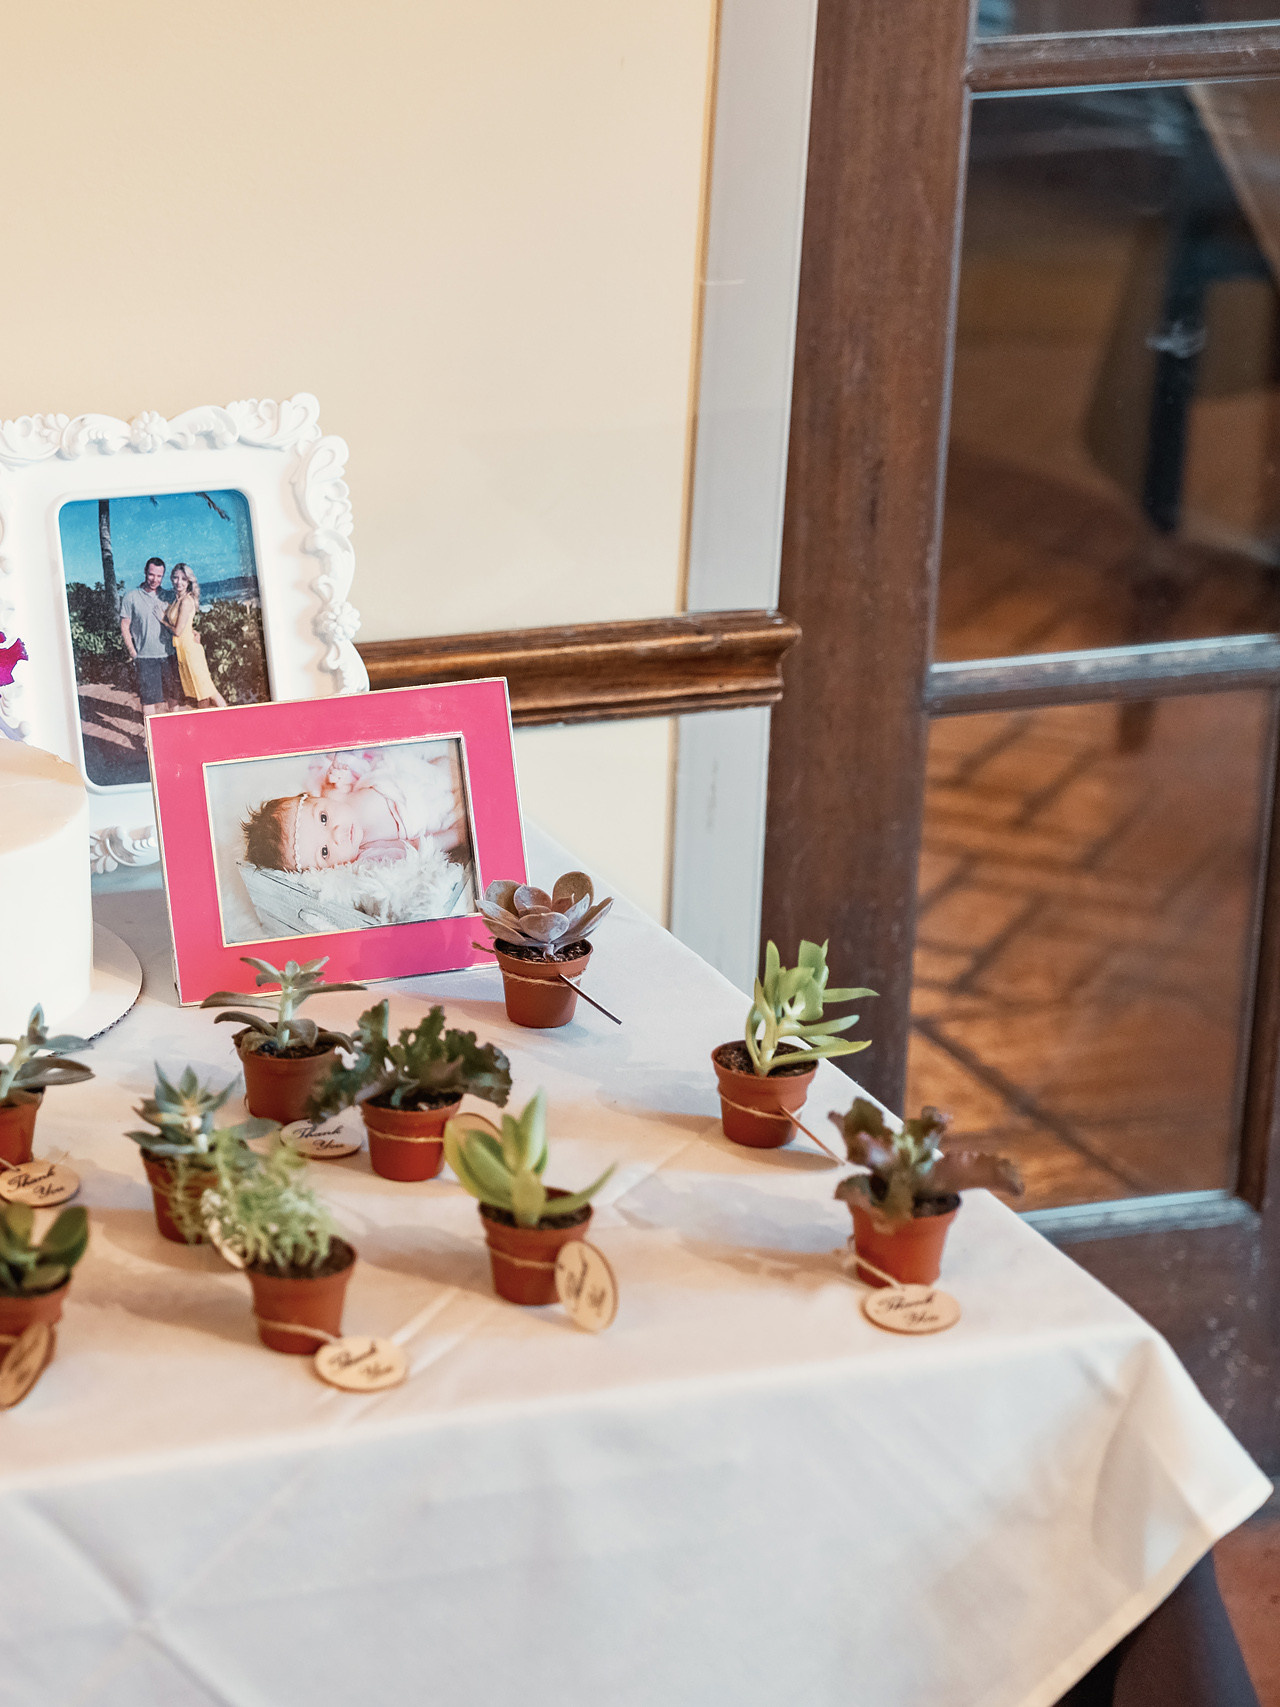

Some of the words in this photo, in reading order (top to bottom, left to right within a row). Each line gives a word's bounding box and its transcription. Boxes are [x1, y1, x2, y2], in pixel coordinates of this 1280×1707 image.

[292, 1124, 344, 1140] Thank
[312, 1138, 345, 1151] You
[7, 1164, 57, 1192] Thank
[33, 1183, 65, 1198] You
[875, 1291, 937, 1314] Thank
